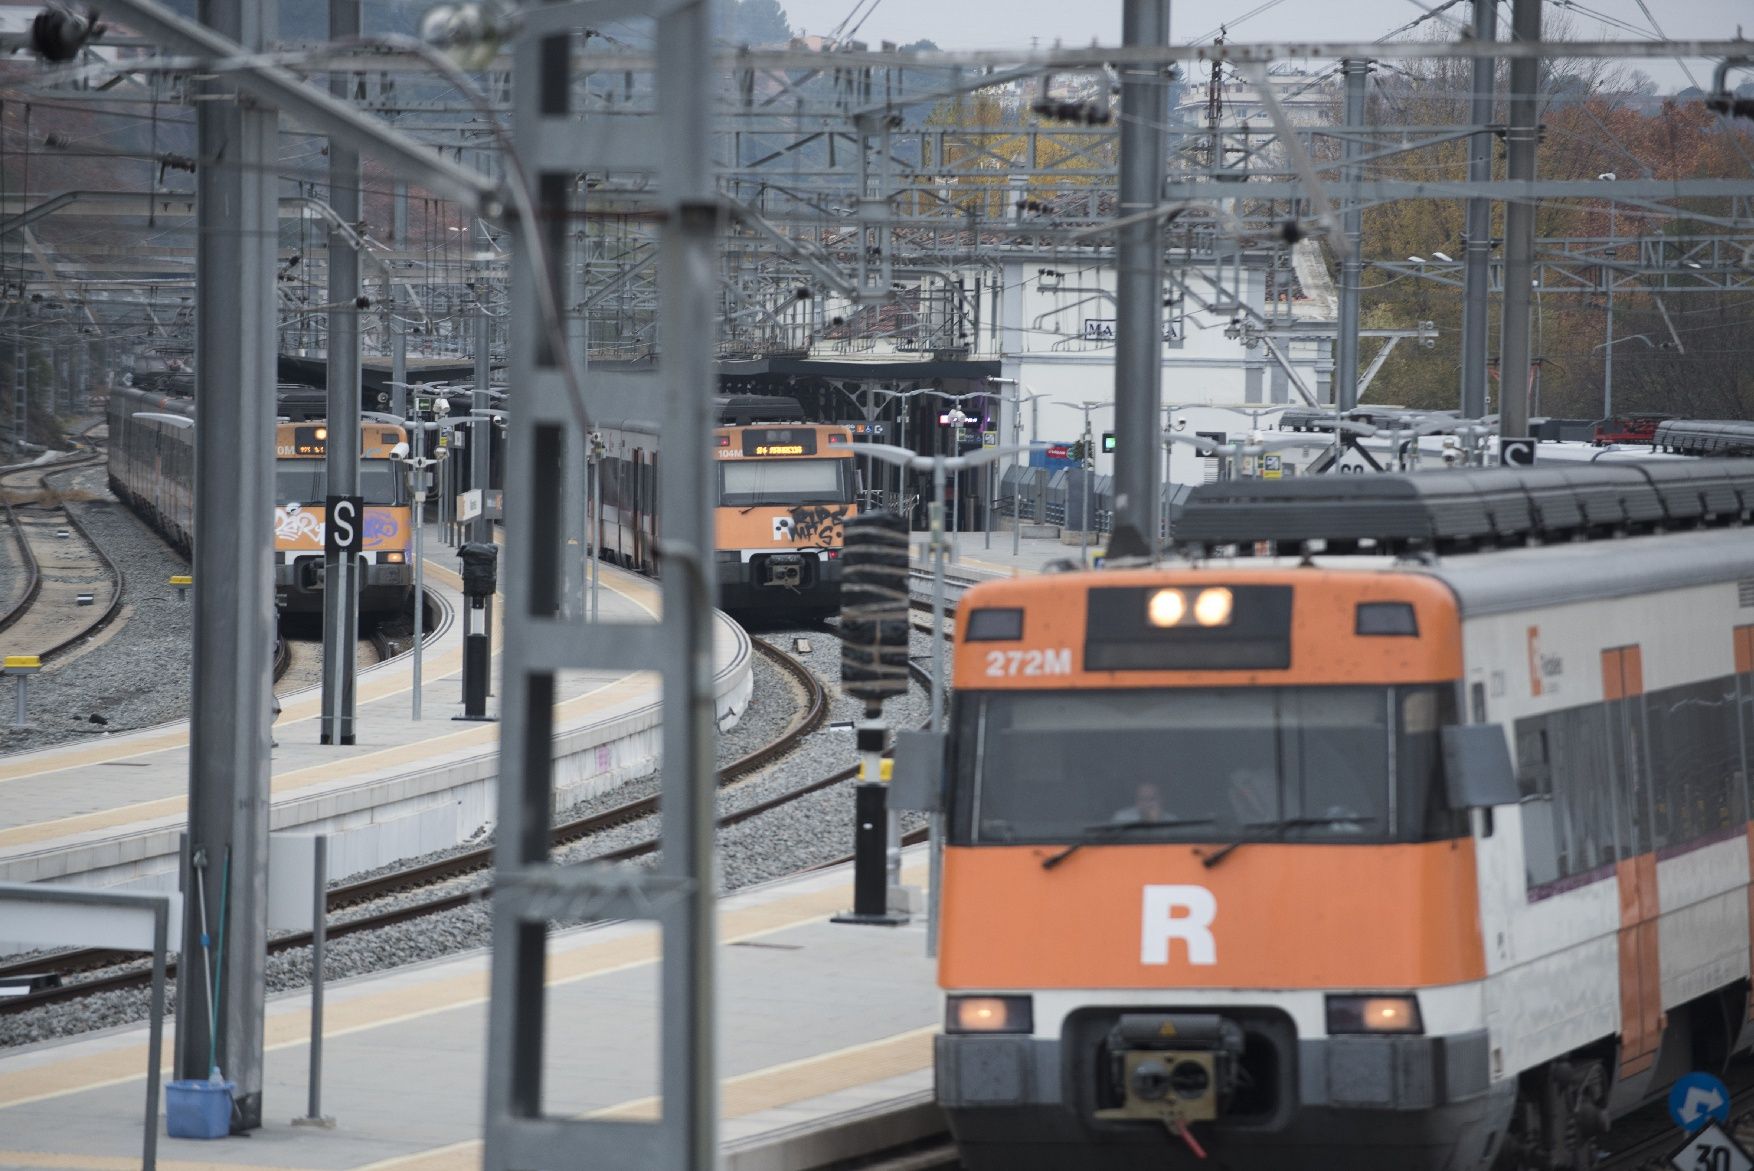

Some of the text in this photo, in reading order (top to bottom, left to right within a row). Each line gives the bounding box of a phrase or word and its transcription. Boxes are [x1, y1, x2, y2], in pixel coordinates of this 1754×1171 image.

[719, 449, 744, 458] 104M
[333, 500, 356, 547] S
[985, 647, 1072, 678] 272M
[1140, 884, 1218, 965] R
[1694, 1143, 1731, 1171] 30
